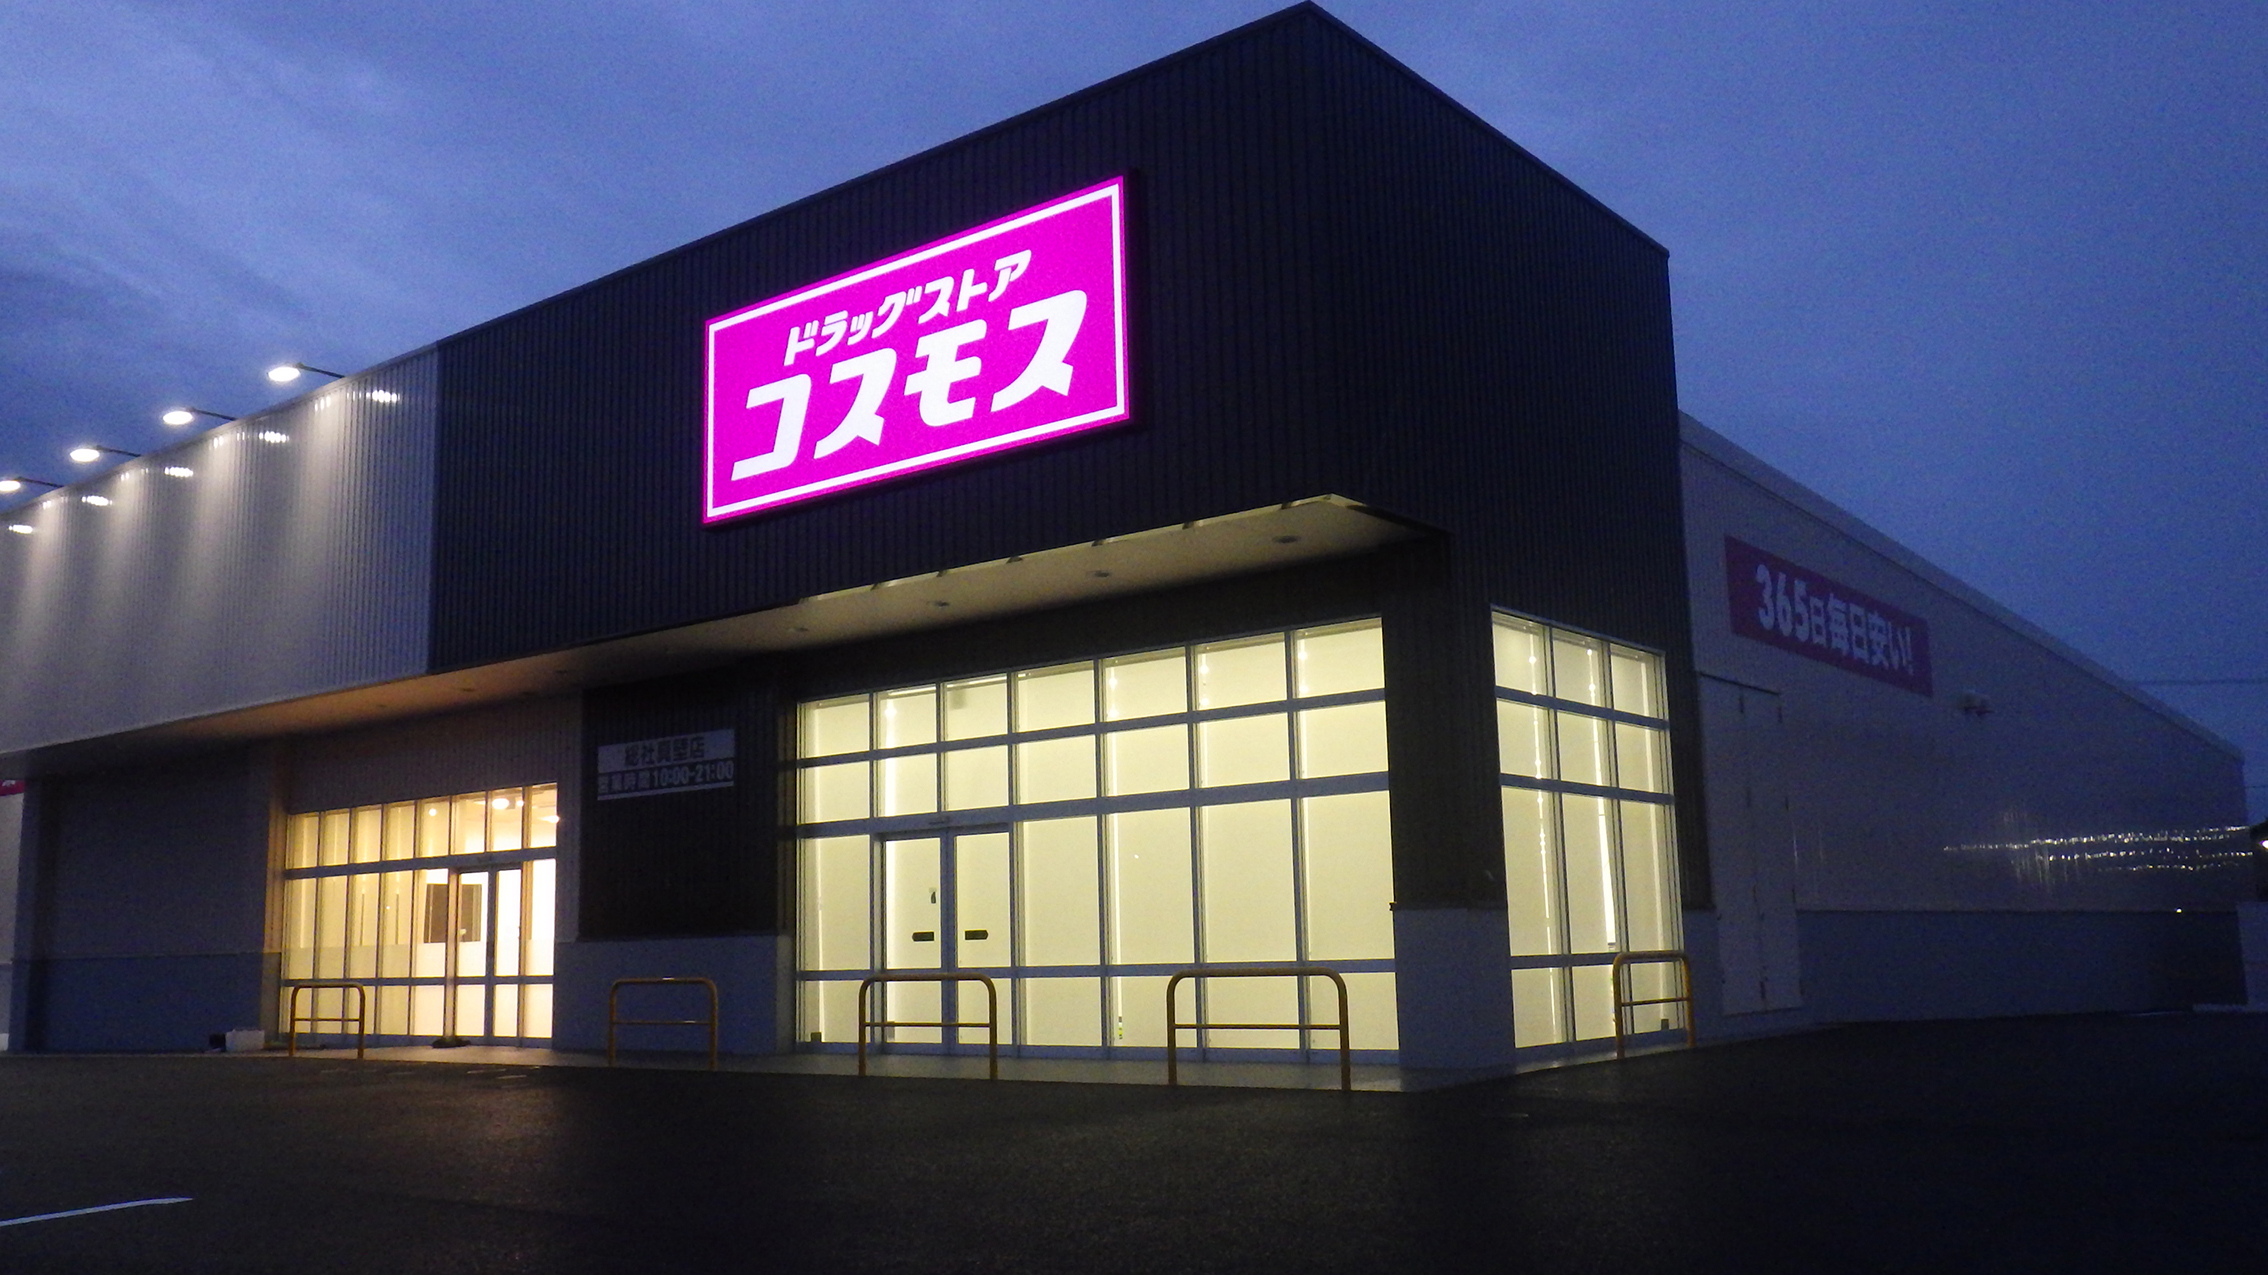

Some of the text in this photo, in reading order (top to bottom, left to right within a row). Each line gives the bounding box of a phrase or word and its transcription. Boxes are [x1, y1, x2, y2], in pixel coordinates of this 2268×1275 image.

[731, 289, 1087, 481] コスモス
[784, 250, 1031, 366] ドラッグストア
